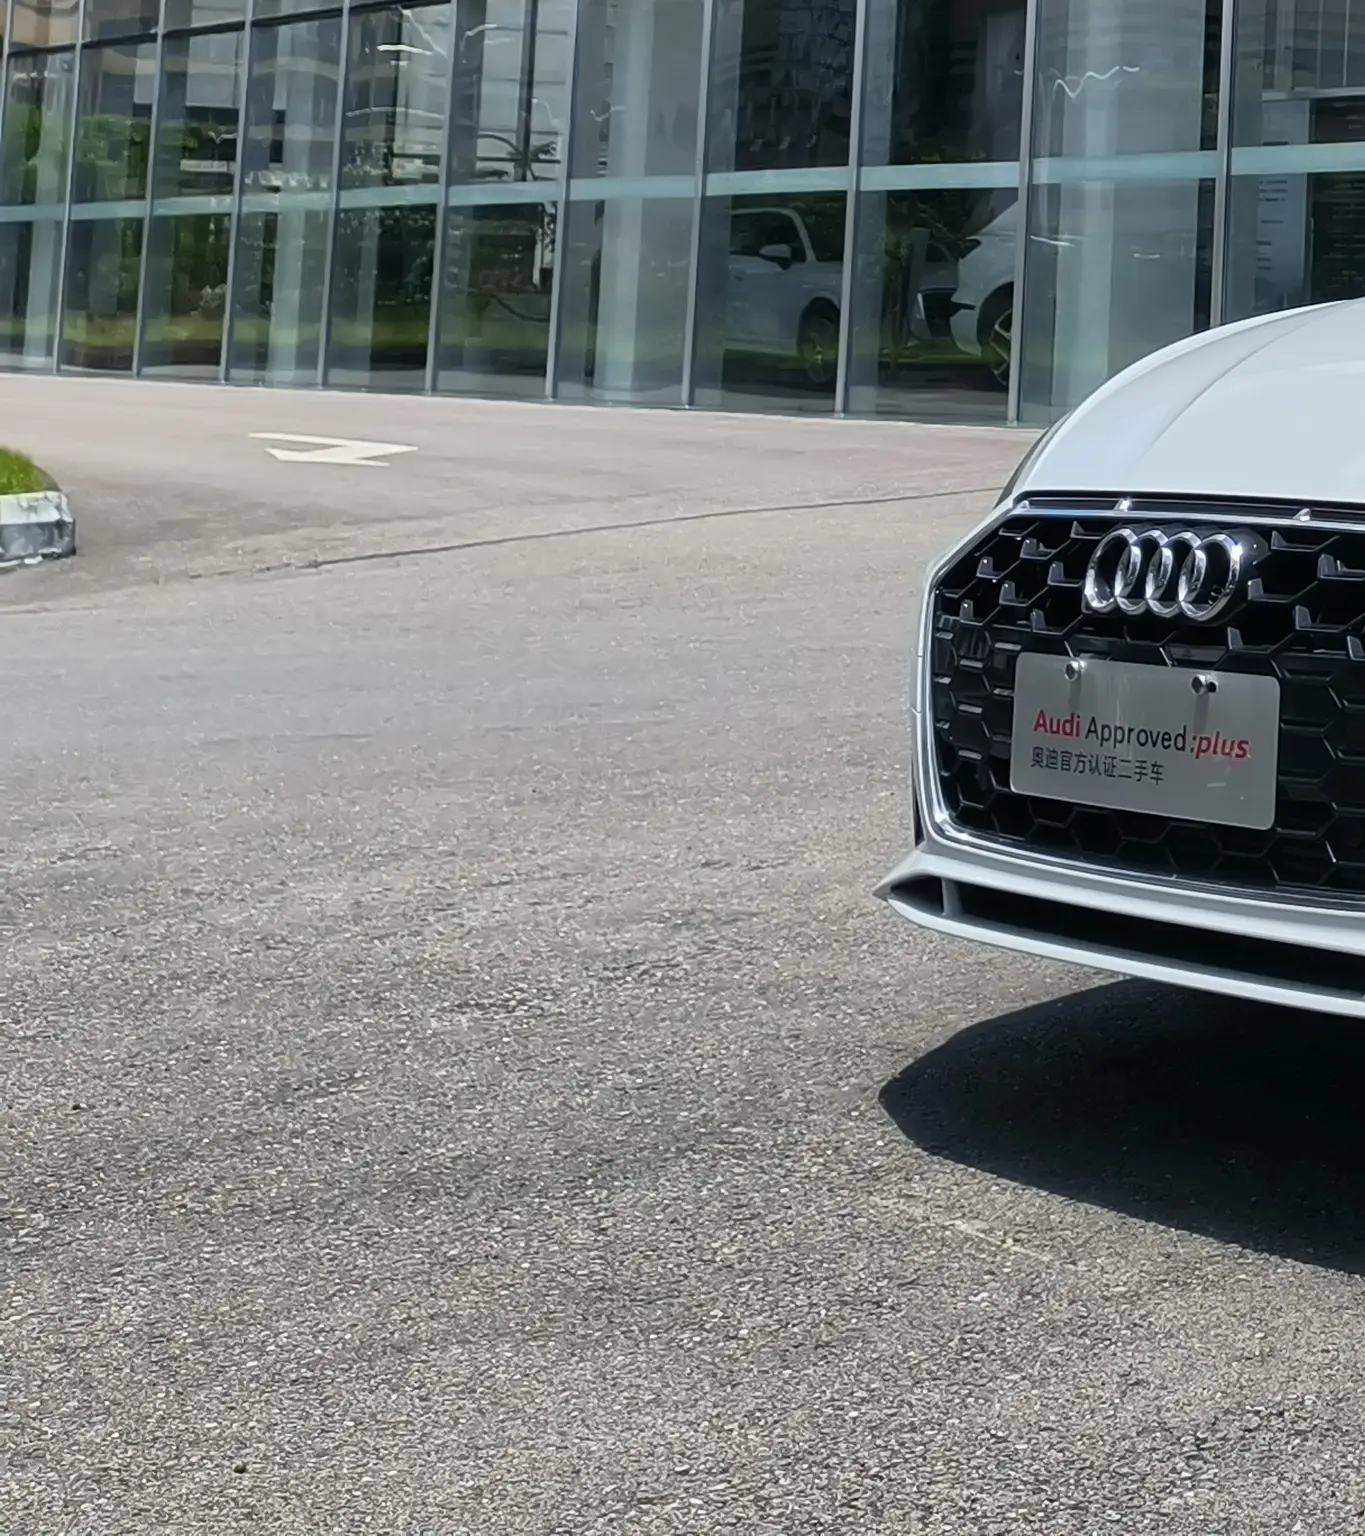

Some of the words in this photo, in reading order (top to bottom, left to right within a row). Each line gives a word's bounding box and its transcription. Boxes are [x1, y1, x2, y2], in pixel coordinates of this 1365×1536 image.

[1033, 709, 1081, 738] Audi
[1085, 715, 1187, 753] Approved
[1030, 746, 1165, 785] 奥迪官方认证二手车
